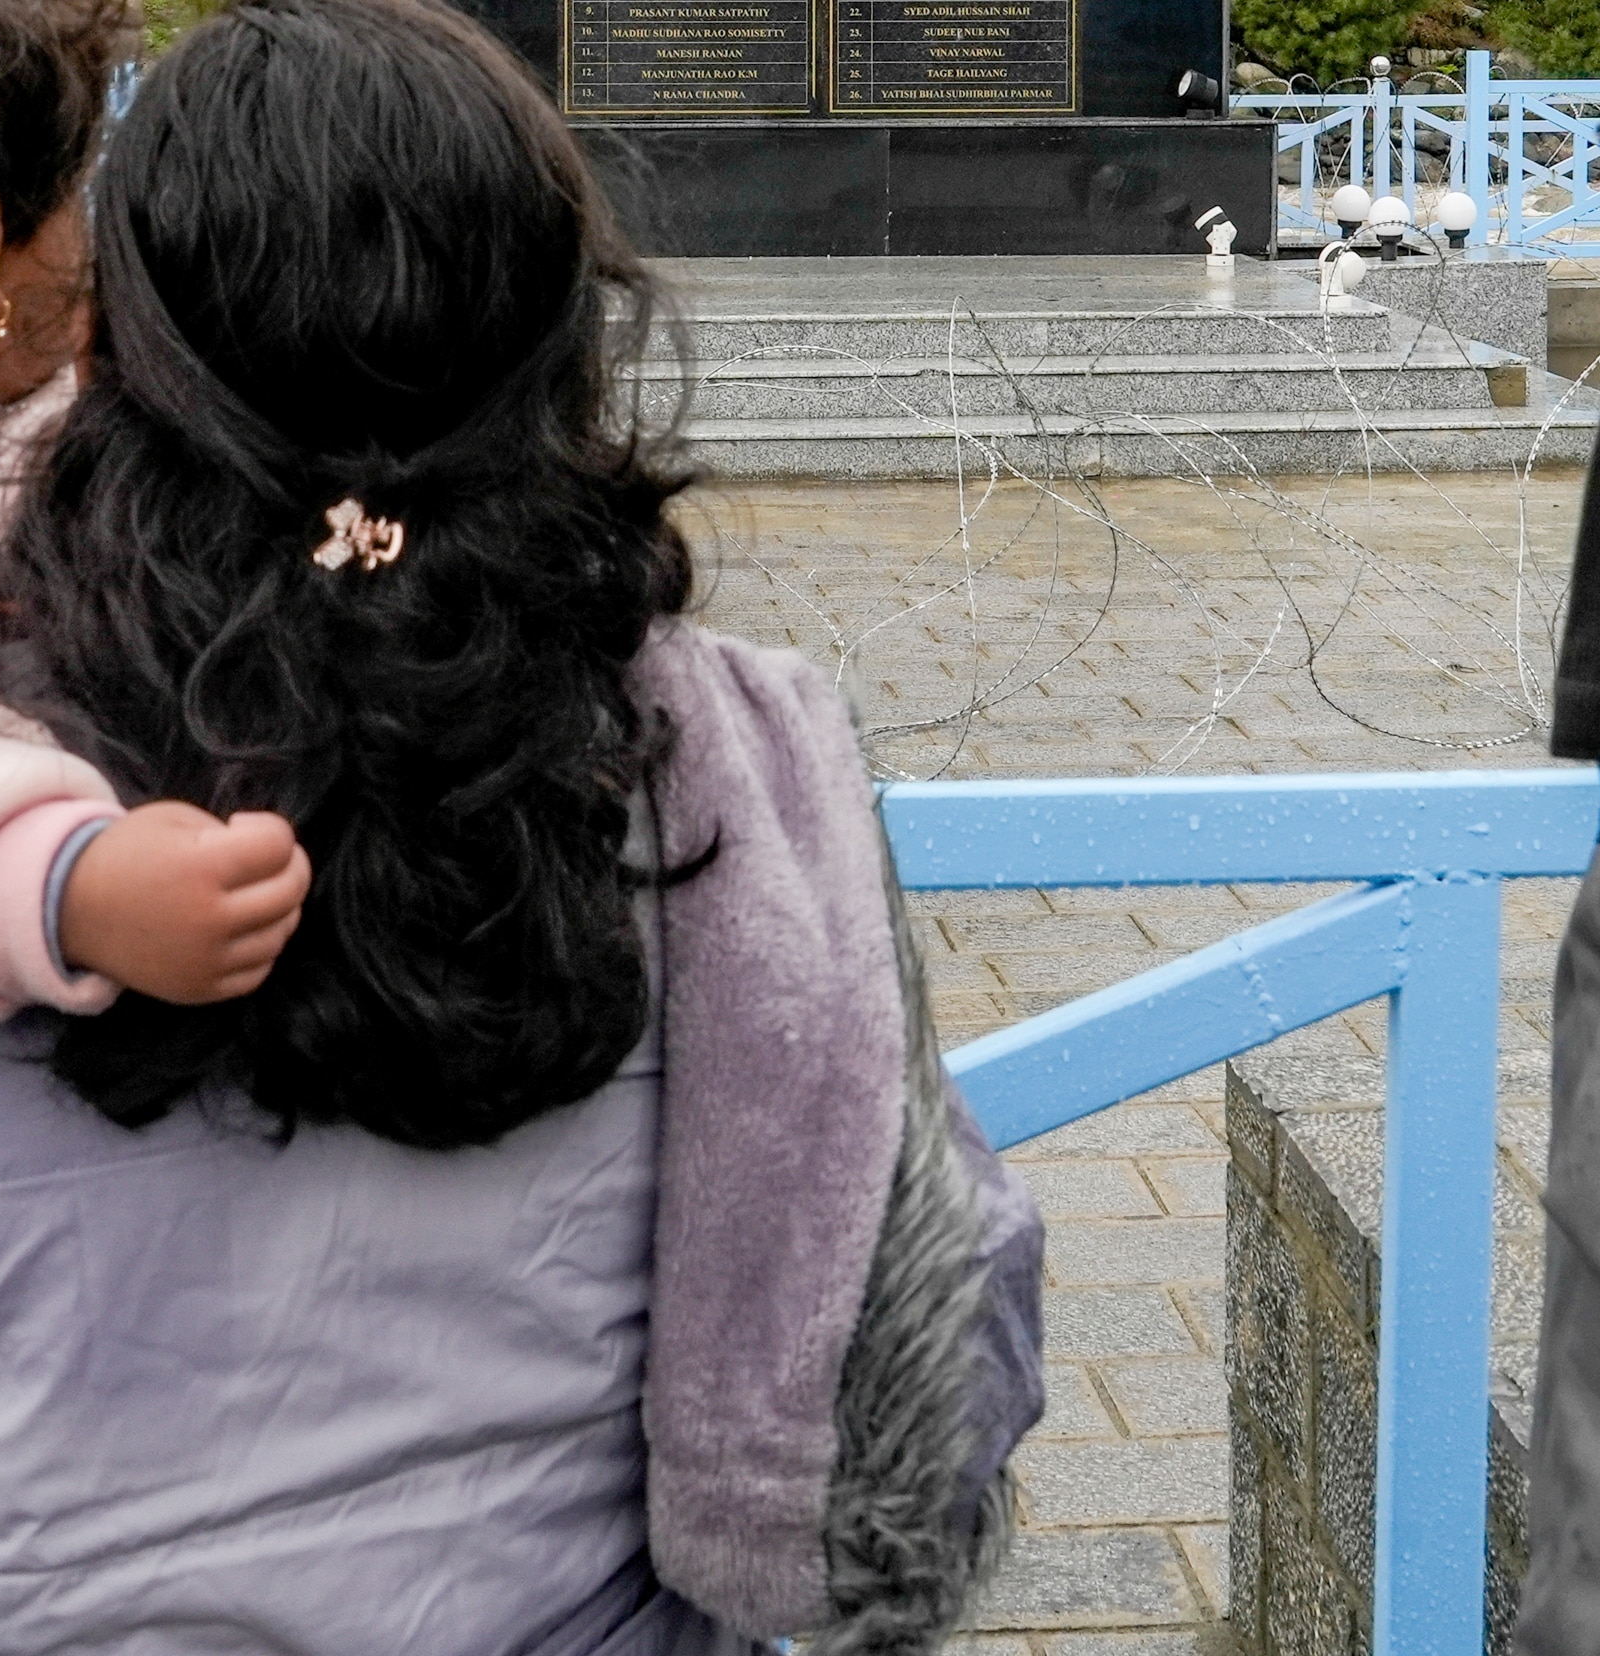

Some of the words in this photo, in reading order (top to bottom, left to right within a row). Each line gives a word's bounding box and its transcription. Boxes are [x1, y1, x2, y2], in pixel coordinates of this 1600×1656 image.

[586, 7, 594, 15] 9.
[629, 9, 677, 17] PRASANT
[679, 9, 717, 17] KUMAR
[719, 9, 770, 17] SATPATHY
[850, 8, 862, 16] 22.
[904, 7, 930, 16] SYED
[932, 7, 955, 16] ADIL
[958, 7, 1001, 16] HUSSAIN
[1003, 7, 1030, 16] SHAH
[582, 27, 594, 35] 10.
[613, 29, 652, 38] MADHU
[653, 29, 702, 38] SUDHANA
[704, 29, 726, 38] RAO
[728, 29, 786, 38] SOMISETTY
[582, 48, 594, 56] 11.
[657, 50, 700, 58] MANESH
[702, 50, 742, 58] RANJAN
[850, 49, 862, 57] 24.
[930, 49, 961, 57] VINAY
[962, 49, 1005, 57] NARWAL
[582, 68, 594, 76] 12.
[642, 70, 712, 78] MANJUNATHA
[713, 70, 735, 78] RAO
[850, 70, 862, 78] 25.
[926, 70, 954, 78] TAGE
[956, 70, 1007, 78] HAILYANG
[582, 89, 594, 97] 13.
[653, 90, 662, 98] N
[663, 90, 693, 98] RAMA
[695, 90, 746, 98] CHANDRA
[850, 91, 862, 99] 26.
[881, 90, 917, 98] YATISH
[919, 90, 945, 98] BHAI
[1010, 90, 1053, 98] PARMAR
